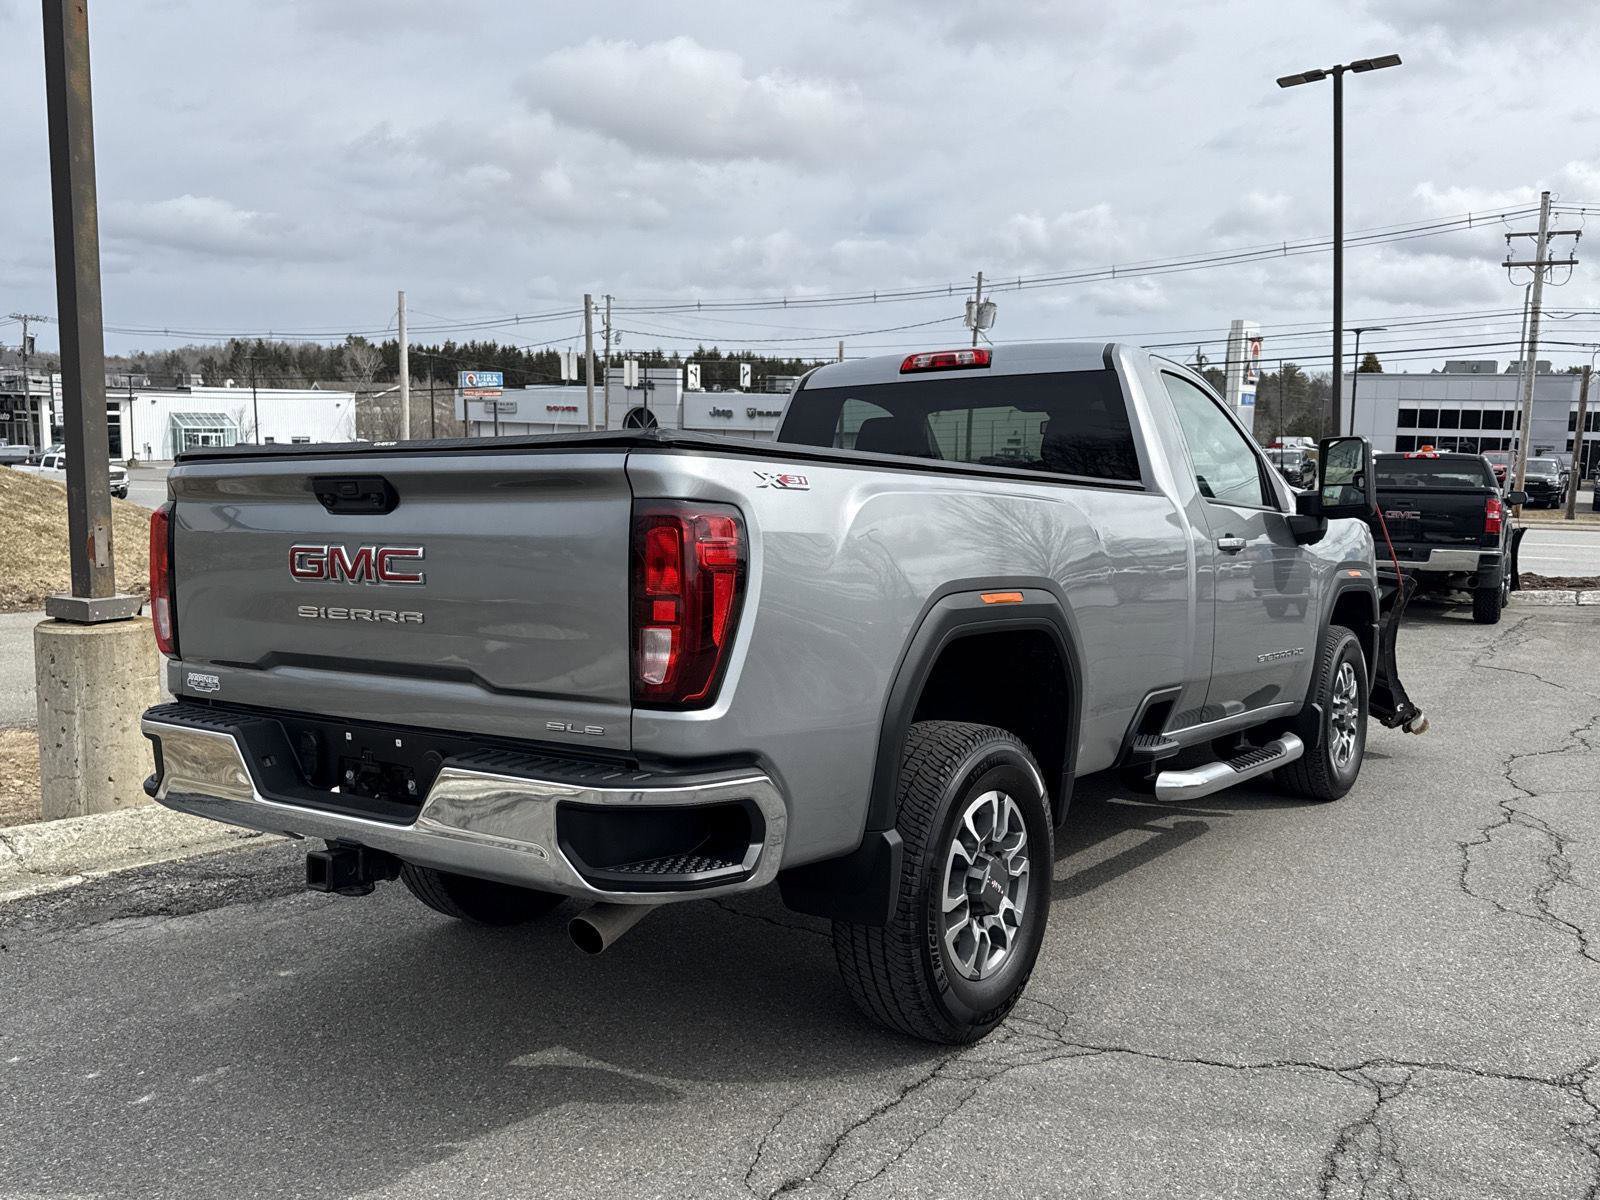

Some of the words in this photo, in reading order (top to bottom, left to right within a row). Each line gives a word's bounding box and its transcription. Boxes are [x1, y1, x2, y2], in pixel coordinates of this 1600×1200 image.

[708, 406, 733, 419] Jeep
[1385, 510, 1421, 519] GMC
[288, 544, 425, 587] GMC
[297, 604, 425, 624] SIERRA
[545, 721, 605, 736] SLE
